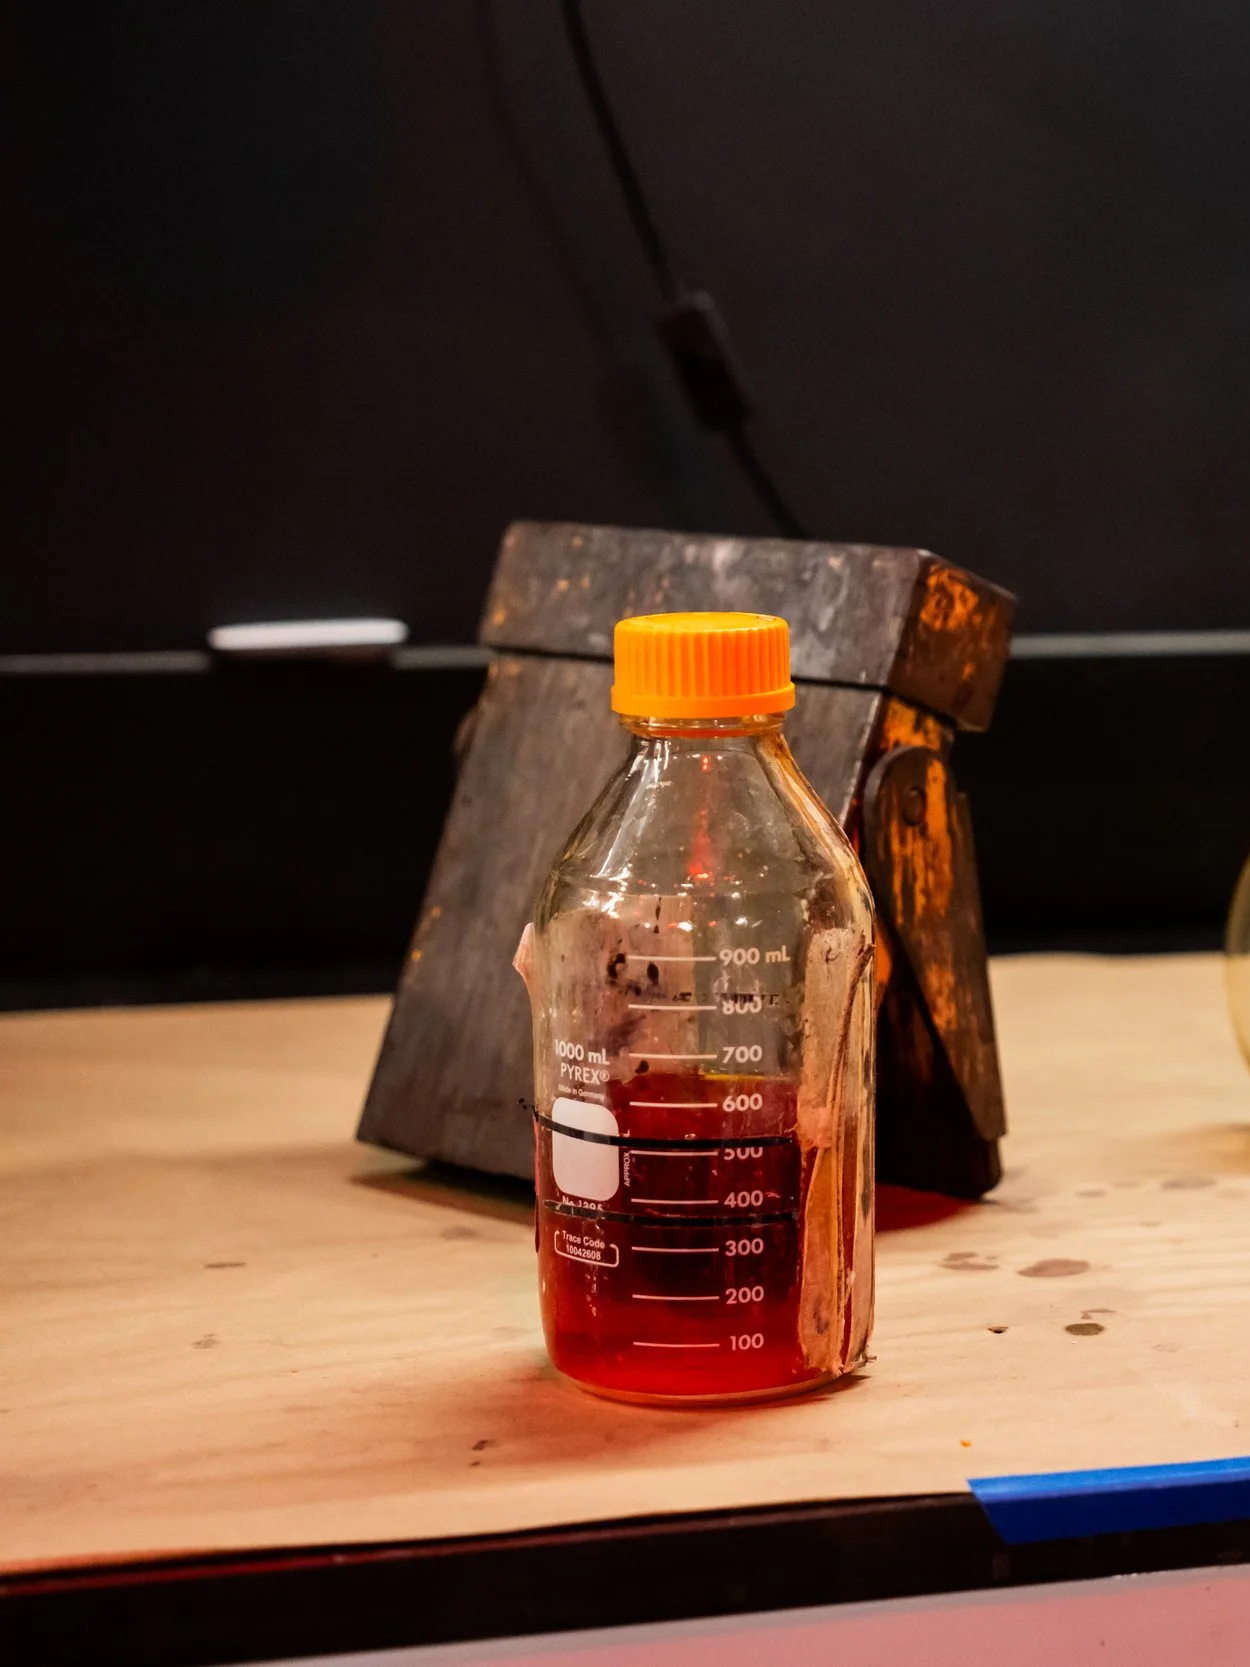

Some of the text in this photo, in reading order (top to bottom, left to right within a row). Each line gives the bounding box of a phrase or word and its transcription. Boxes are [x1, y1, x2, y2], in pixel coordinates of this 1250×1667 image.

[719, 945, 791, 965] 900 mL
[554, 1039, 610, 1065] 1000 mL
[722, 1045, 763, 1064] 700
[722, 1093, 763, 1113] 600
[723, 1190, 764, 1209] 400
[562, 1230, 606, 1249] Trace Code
[725, 1238, 764, 1257] 300
[566, 1243, 602, 1261] 10042608
[725, 1286, 765, 1304] 200
[730, 1333, 765, 1351] 100
